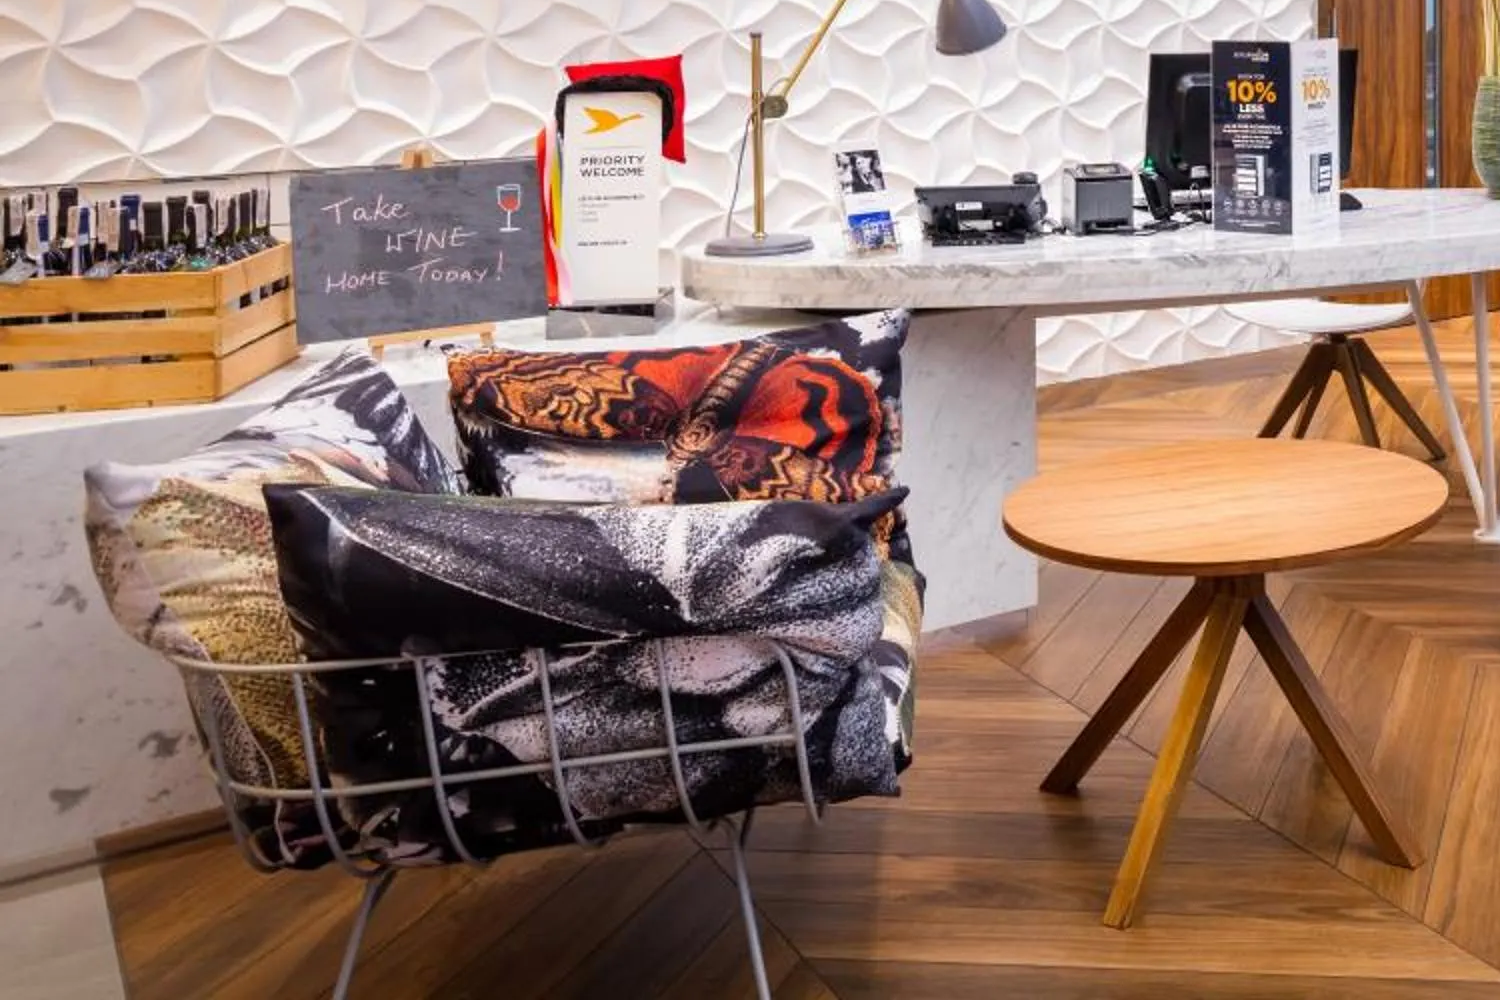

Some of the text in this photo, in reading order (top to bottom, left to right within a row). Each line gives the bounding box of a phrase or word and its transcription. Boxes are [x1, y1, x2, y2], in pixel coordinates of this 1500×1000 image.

[1226, 79, 1278, 104] 10%
[1301, 77, 1331, 102] 10%
[1239, 103, 1265, 114] LESS
[579, 154, 645, 166] PRIORITY
[579, 166, 645, 178] WELCOME
[320, 193, 411, 225] Take
